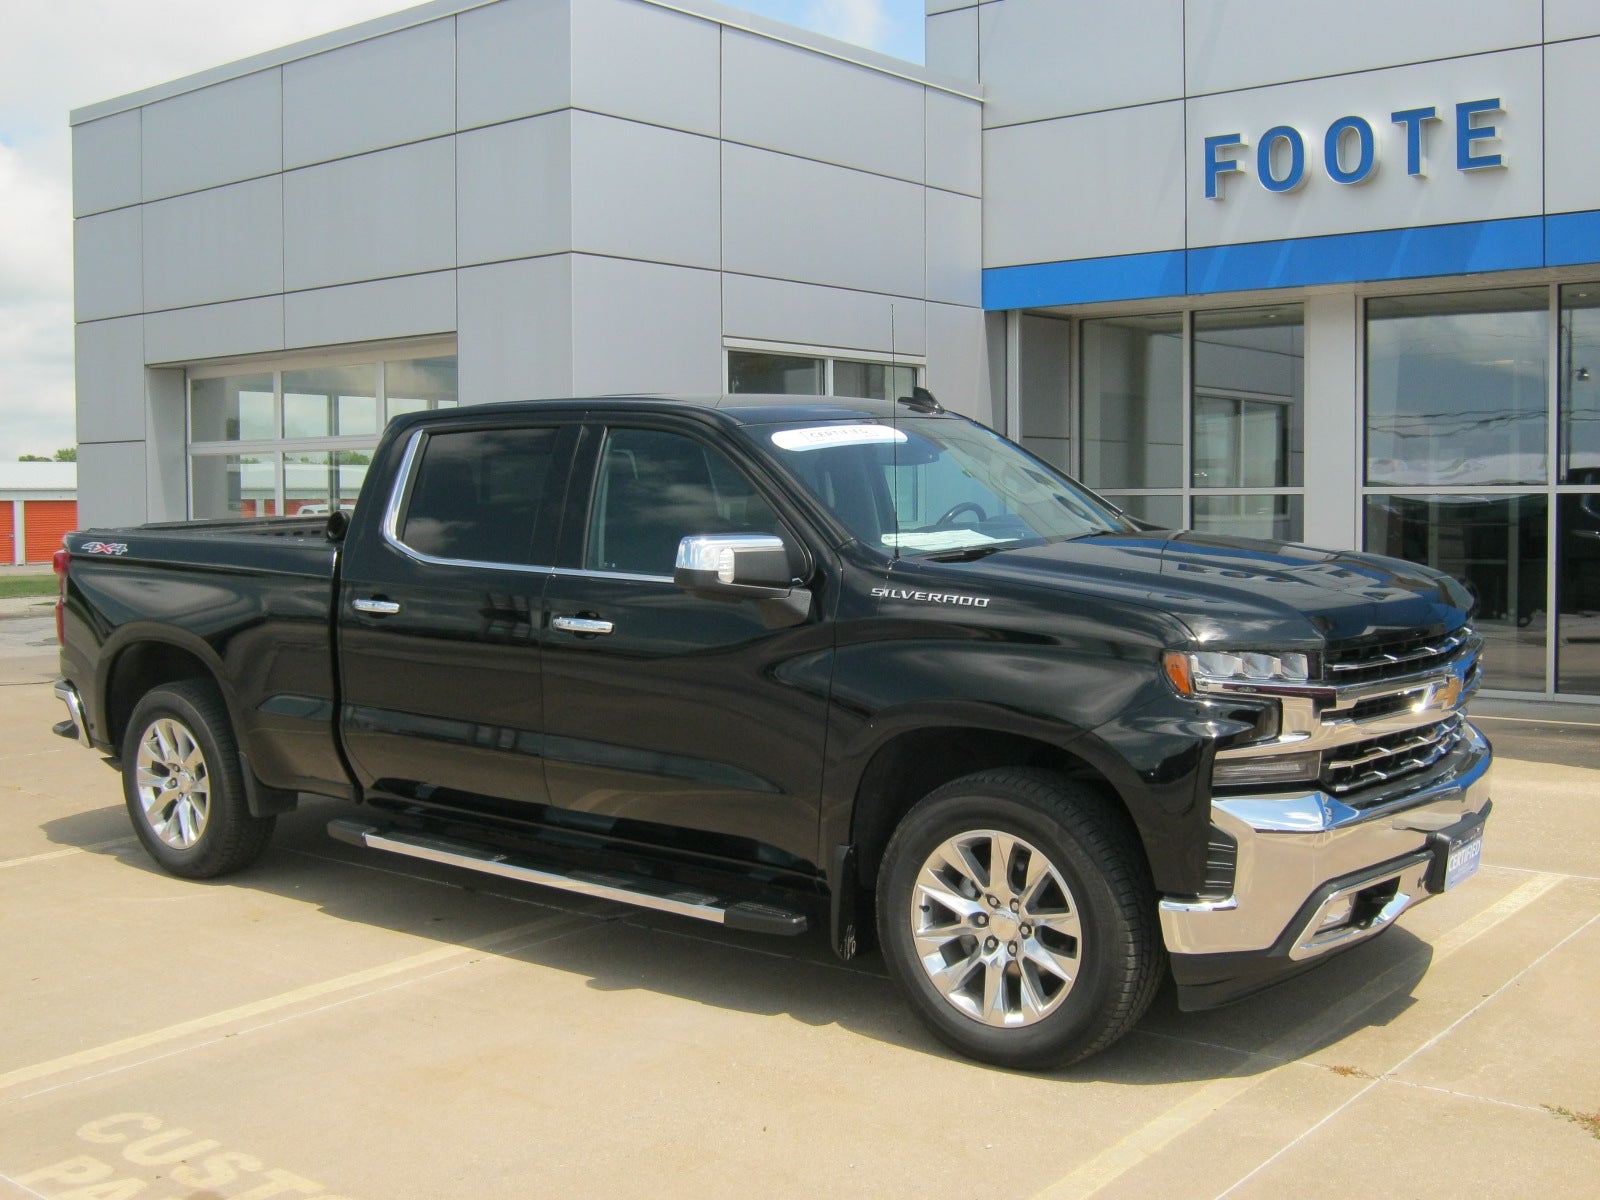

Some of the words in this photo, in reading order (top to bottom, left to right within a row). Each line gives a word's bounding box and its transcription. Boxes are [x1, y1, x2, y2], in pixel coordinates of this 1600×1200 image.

[1203, 97, 1507, 200] FOOTE
[870, 587, 990, 608] SILVERADO
[1448, 839, 1481, 872] CERTIFIED
[76, 1112, 350, 1200] CUST
